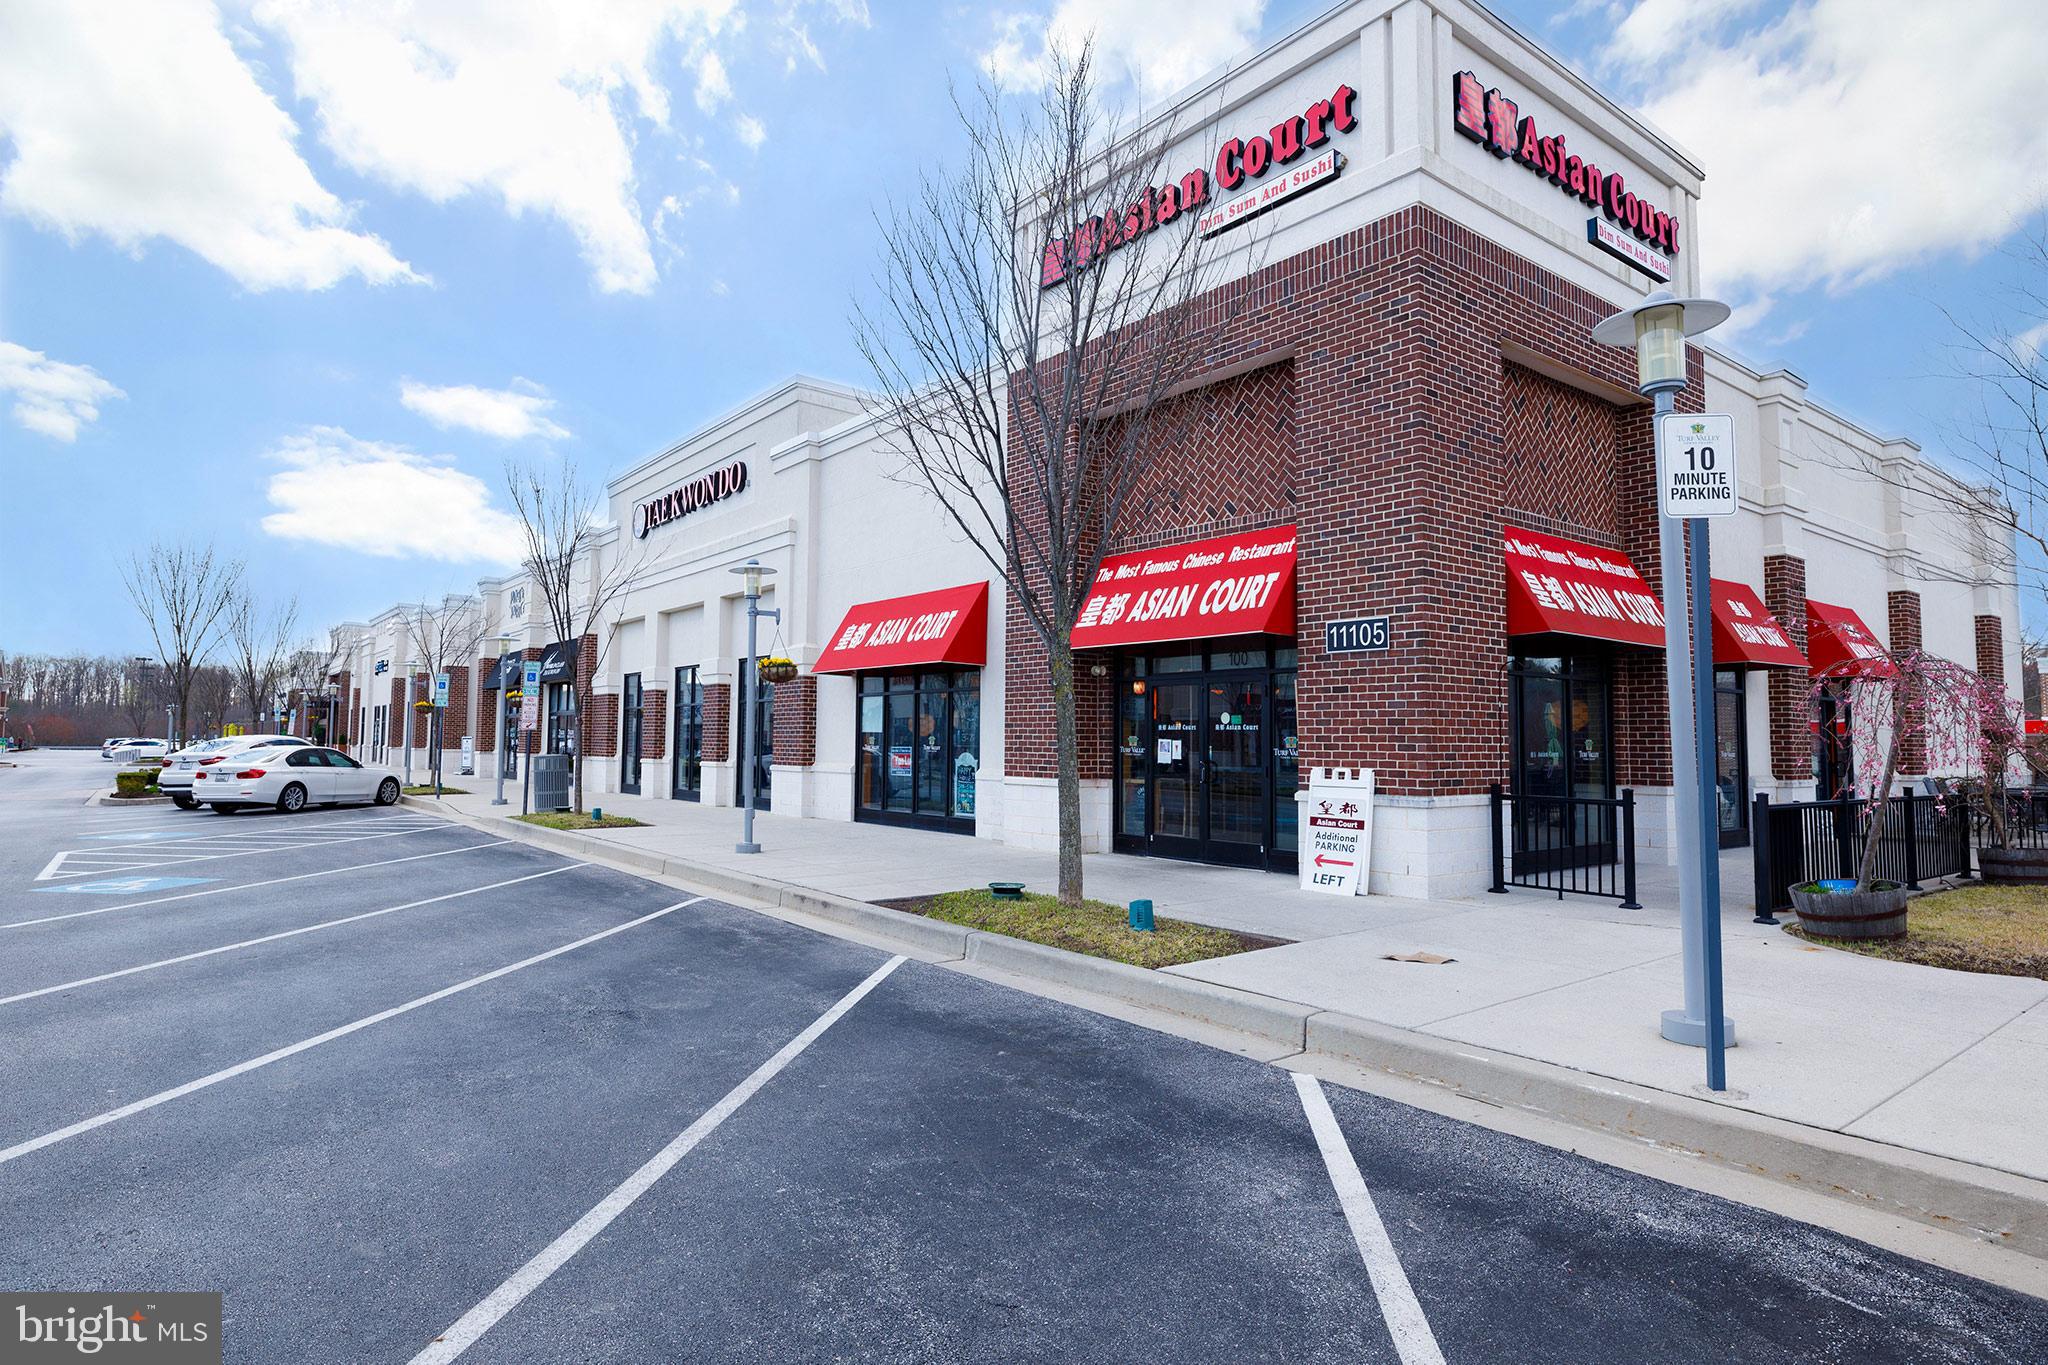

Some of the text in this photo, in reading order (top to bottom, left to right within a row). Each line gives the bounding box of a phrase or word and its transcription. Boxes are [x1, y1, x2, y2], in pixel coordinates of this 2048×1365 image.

[1097, 84, 1358, 256] Asian Court
[1512, 116, 1680, 256] Asian Court
[1200, 156, 1333, 233] Dim Sum And Sushi
[1598, 223, 1670, 276] Dim Sum And Sushi
[1684, 447, 1715, 470] 10
[646, 461, 747, 530] TAEKWONDO
[1671, 487, 1731, 500] PARKING
[1674, 472, 1727, 485] MINUTE
[1096, 537, 1296, 583] The Most Famous Chinese Restaurant
[1076, 592, 1133, 628] 皇都
[1125, 572, 1280, 623] ASIAN COURT
[1565, 580, 1666, 627] ASIAN COURT
[864, 609, 959, 647] ASIAN COURT
[1329, 622, 1385, 648] 11105
[1229, 649, 1248, 666] 100
[1315, 831, 1358, 843] Additional
[1316, 818, 1358, 829] Asian Court
[1315, 841, 1355, 853] PARKING
[1313, 872, 1345, 887] LEFT
